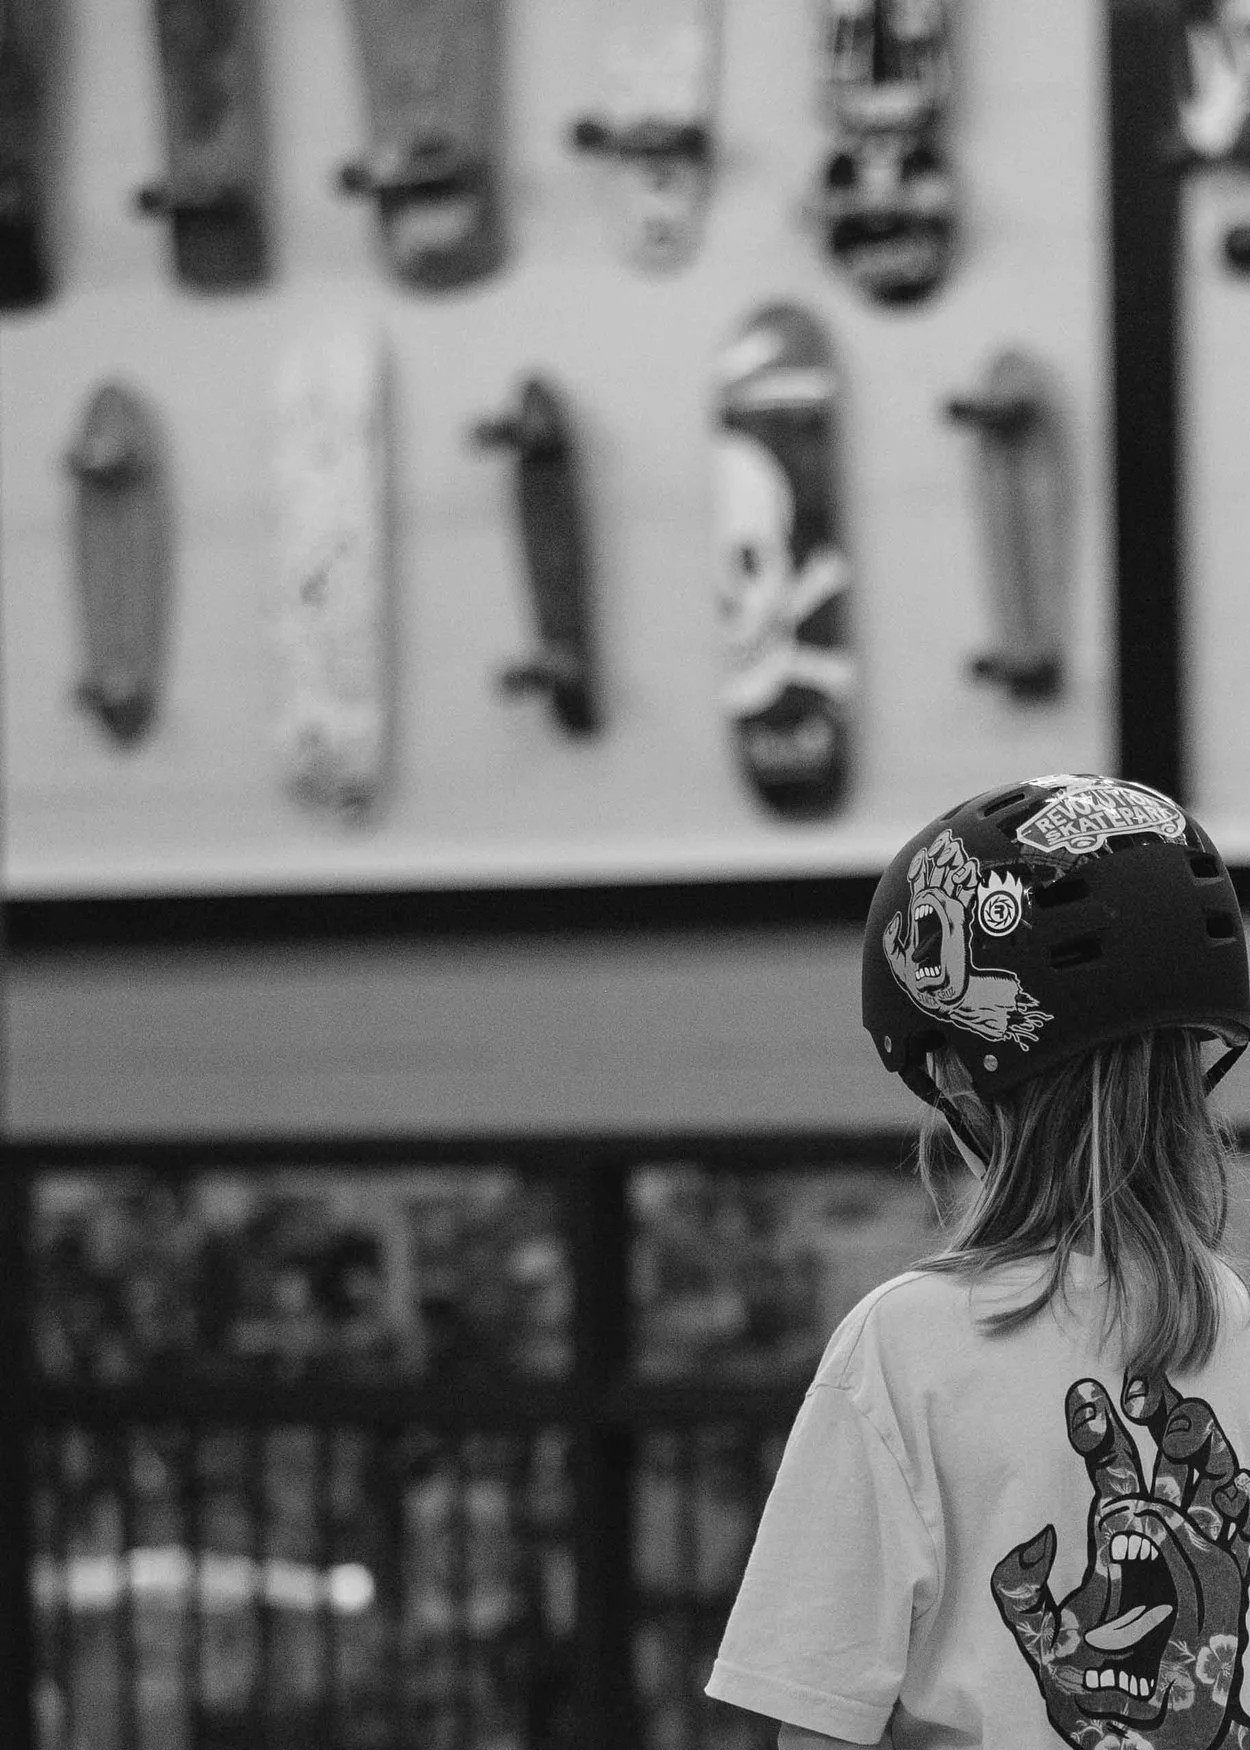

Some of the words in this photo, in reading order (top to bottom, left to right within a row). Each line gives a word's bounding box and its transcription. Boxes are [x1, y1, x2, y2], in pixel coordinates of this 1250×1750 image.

[1035, 788, 1160, 832] REVOLUTION
[1045, 804, 1173, 842] SKATEPARK
[937, 986, 956, 999] CRUZ
